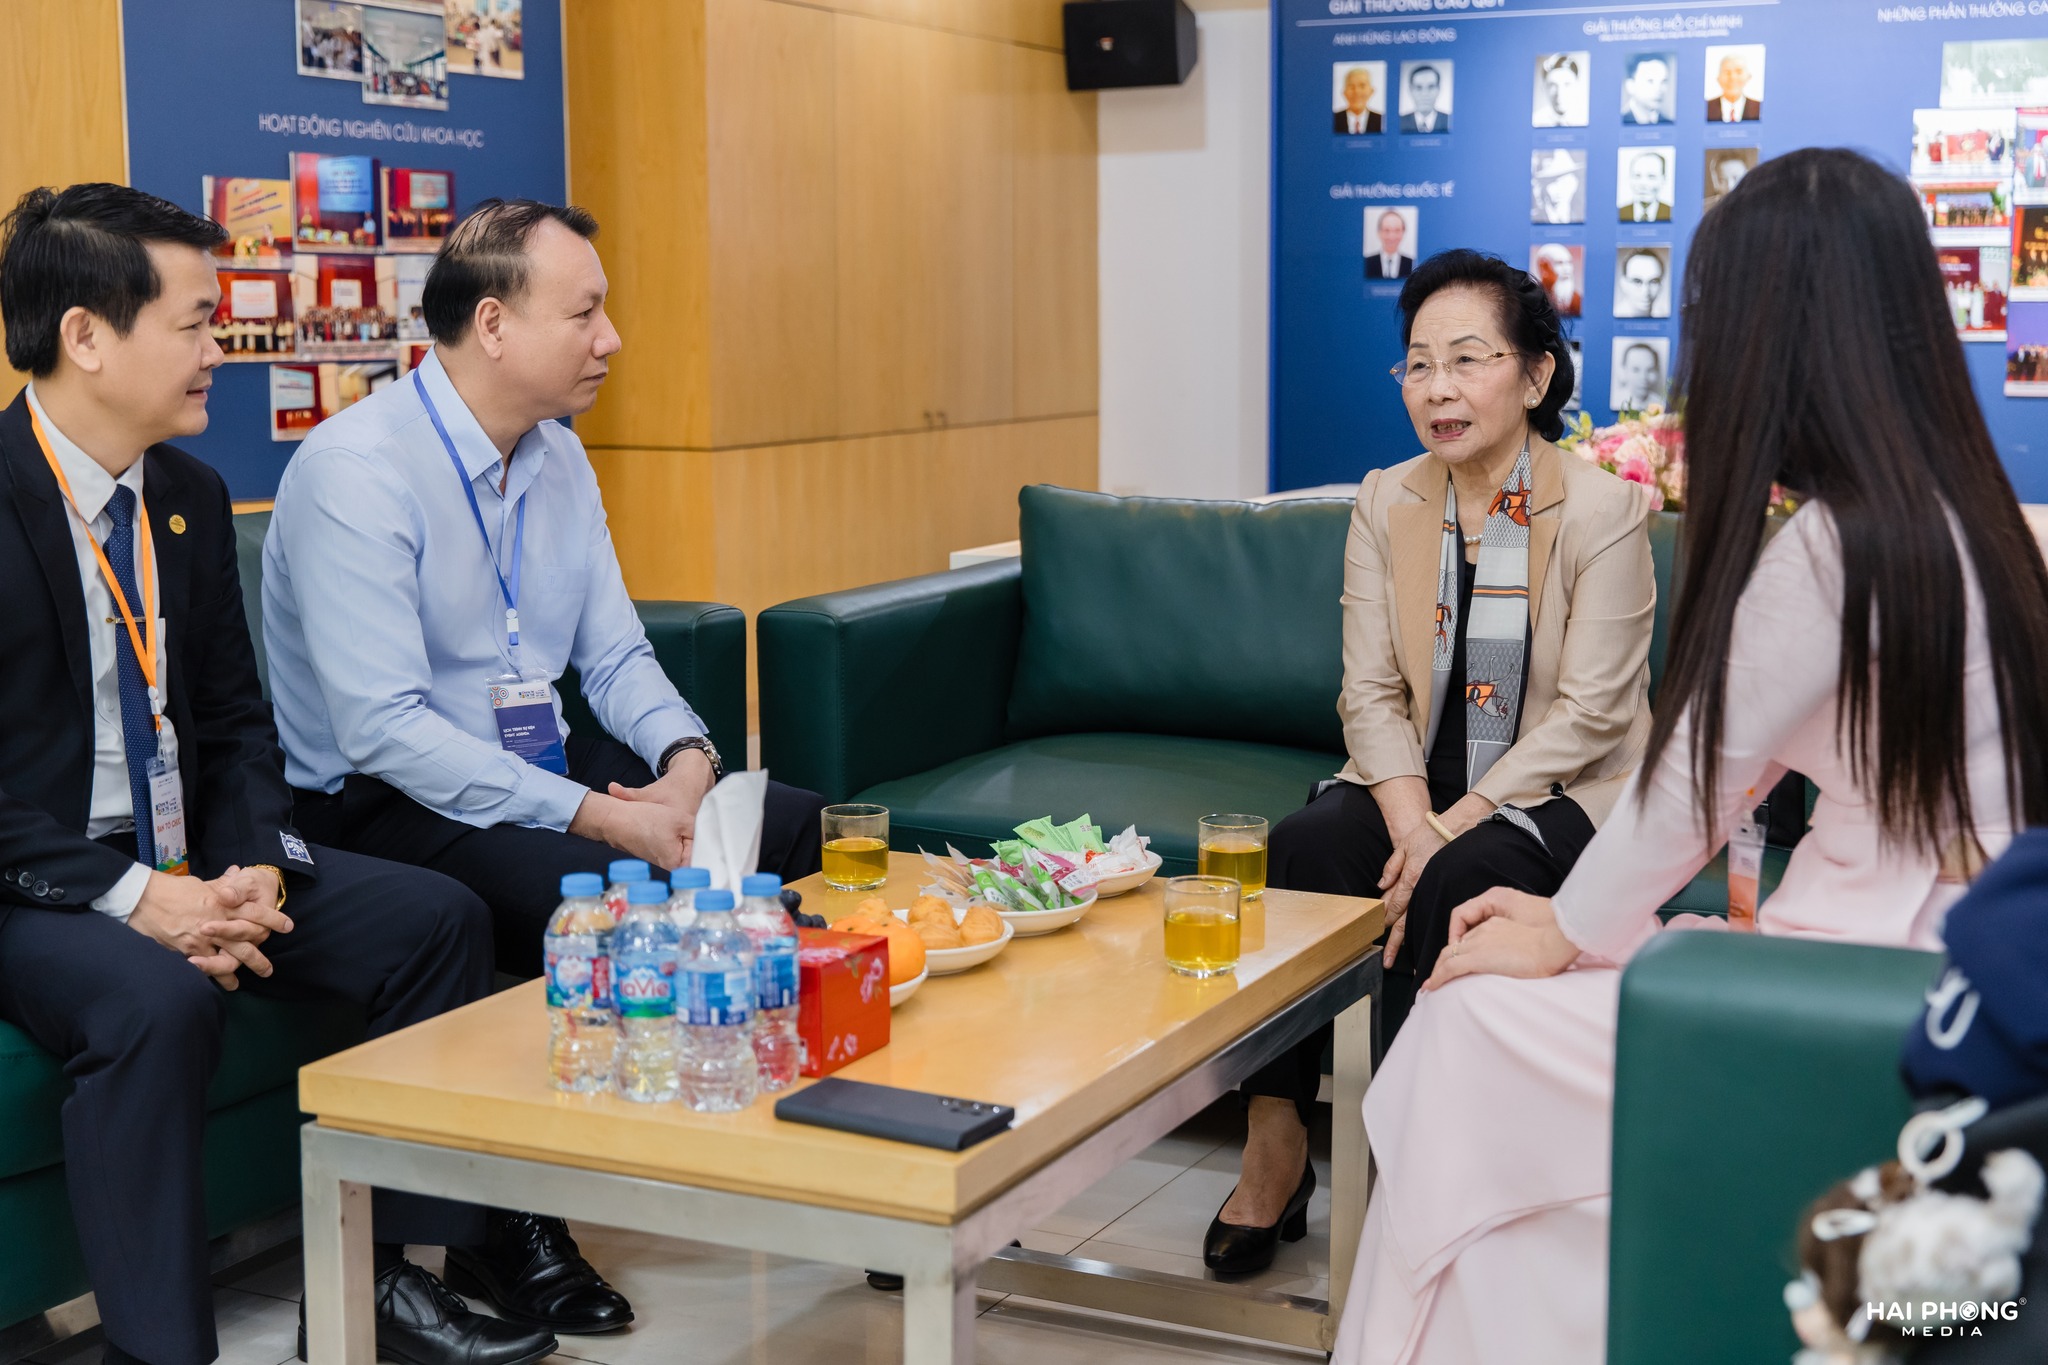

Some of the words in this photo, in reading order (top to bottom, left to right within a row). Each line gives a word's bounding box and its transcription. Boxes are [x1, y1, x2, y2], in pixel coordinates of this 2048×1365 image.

[1710, 14, 1743, 29] MINH
[1393, 28, 1419, 44] LAO
[258, 113, 296, 137] HOẠT
[298, 113, 343, 139] ĐỘNG
[343, 119, 392, 141] NGHIÊN
[420, 127, 455, 145] KHOA
[455, 128, 485, 150] HỌC
